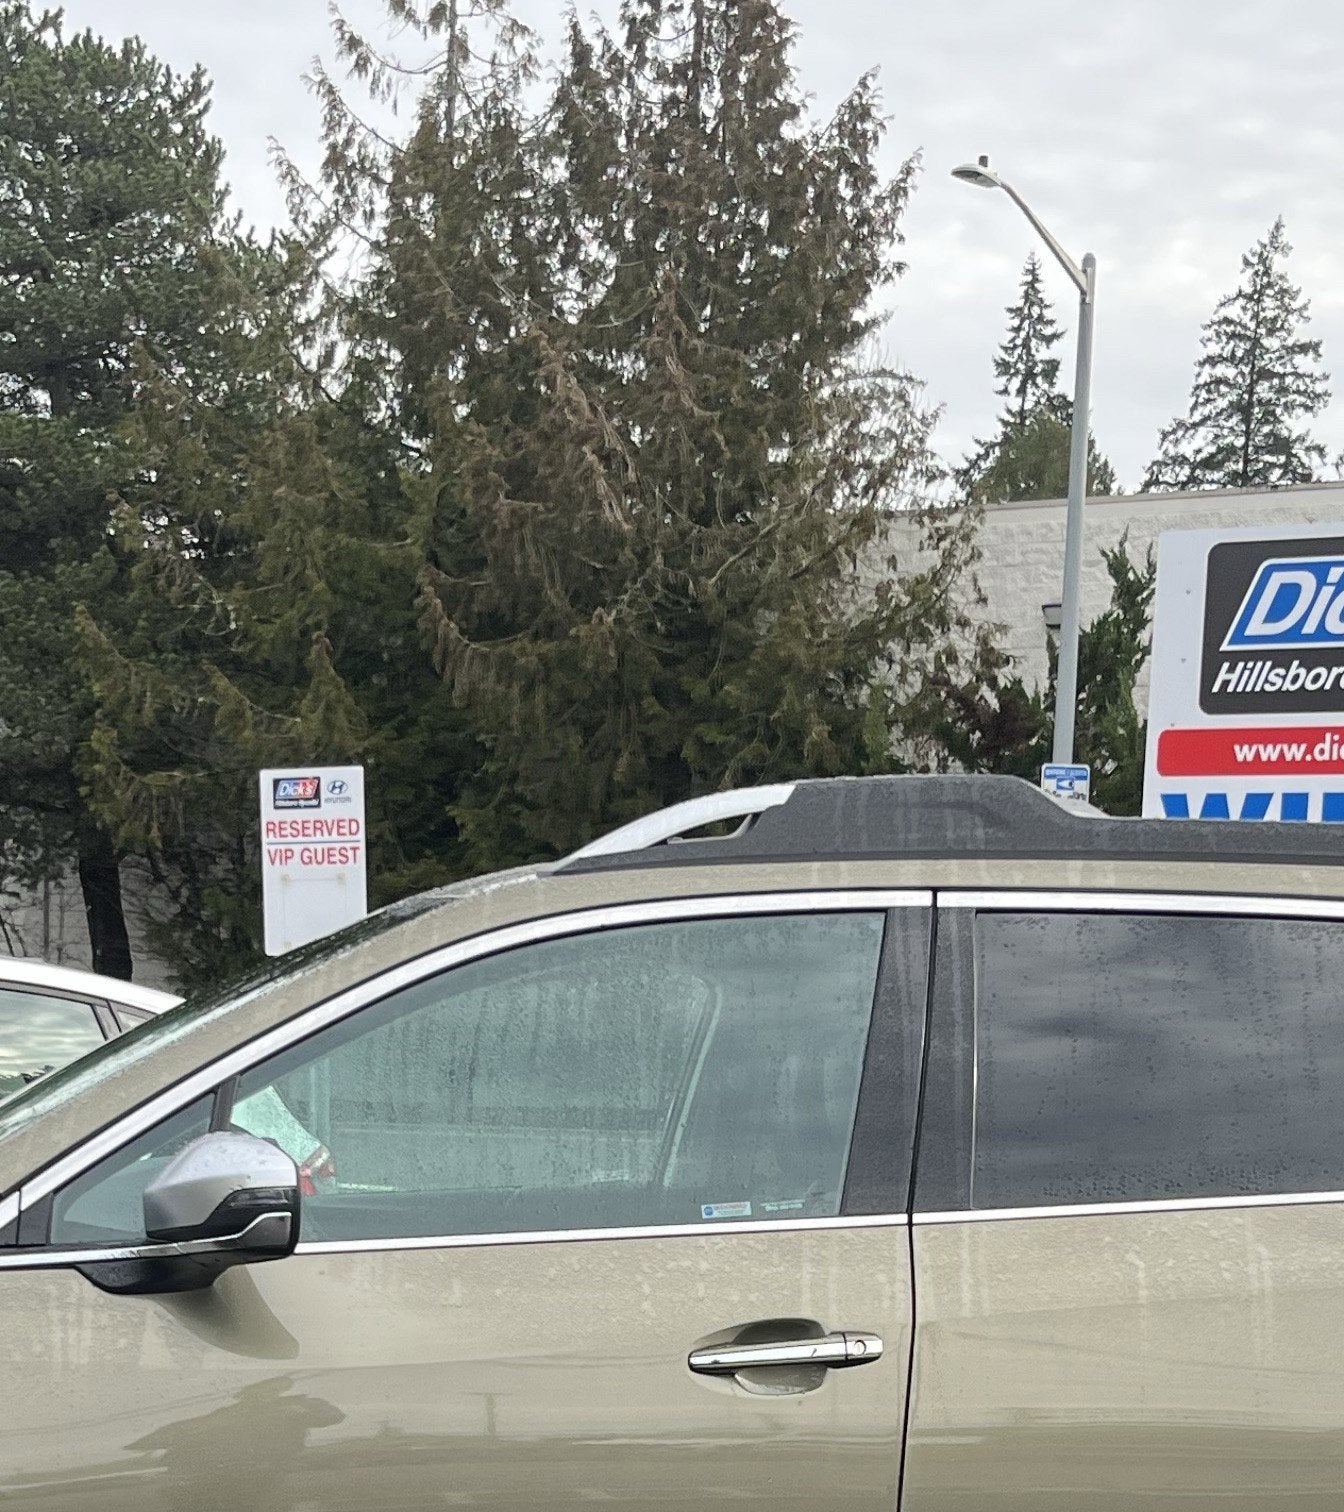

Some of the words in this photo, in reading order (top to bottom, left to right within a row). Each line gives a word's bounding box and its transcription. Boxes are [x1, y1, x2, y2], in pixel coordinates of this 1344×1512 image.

[265, 819, 360, 838] RESERVED
[267, 848, 294, 866] VIP
[300, 846, 360, 865] GUEST
